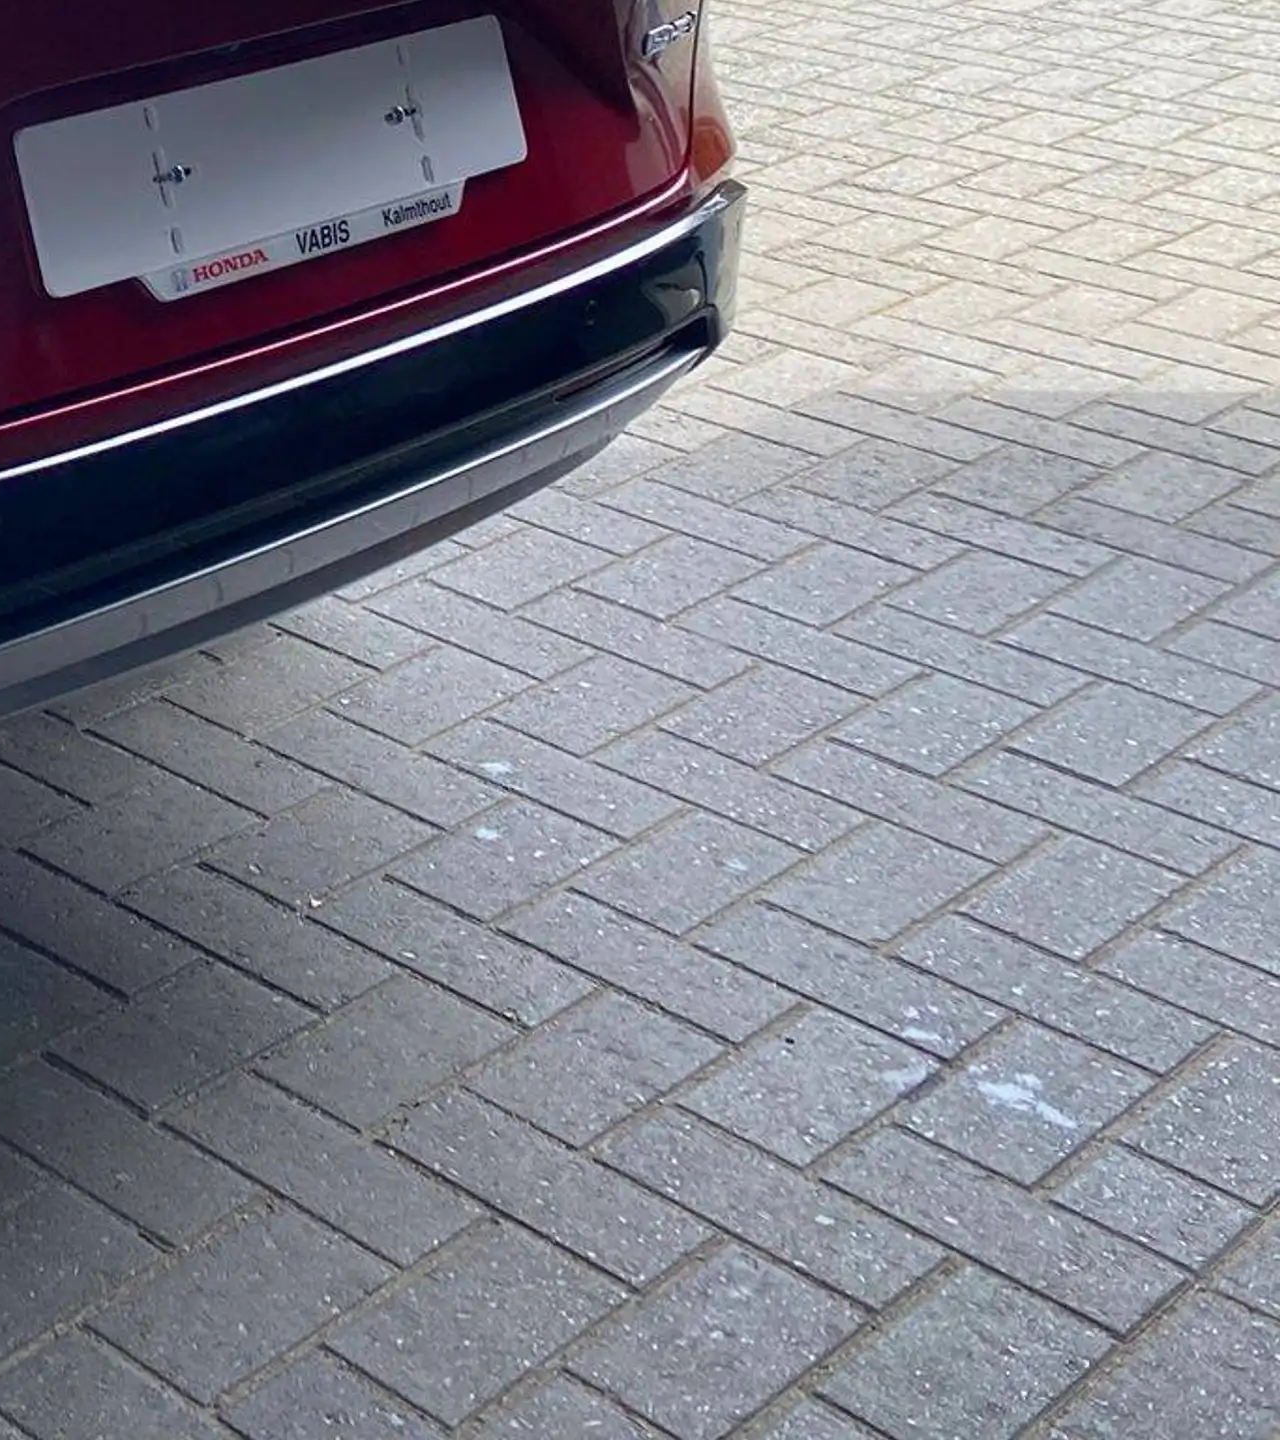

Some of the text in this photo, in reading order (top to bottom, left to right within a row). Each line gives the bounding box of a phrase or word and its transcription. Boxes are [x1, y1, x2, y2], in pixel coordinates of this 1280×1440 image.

[192, 191, 453, 284] HONDA VABIS Kalmthout
